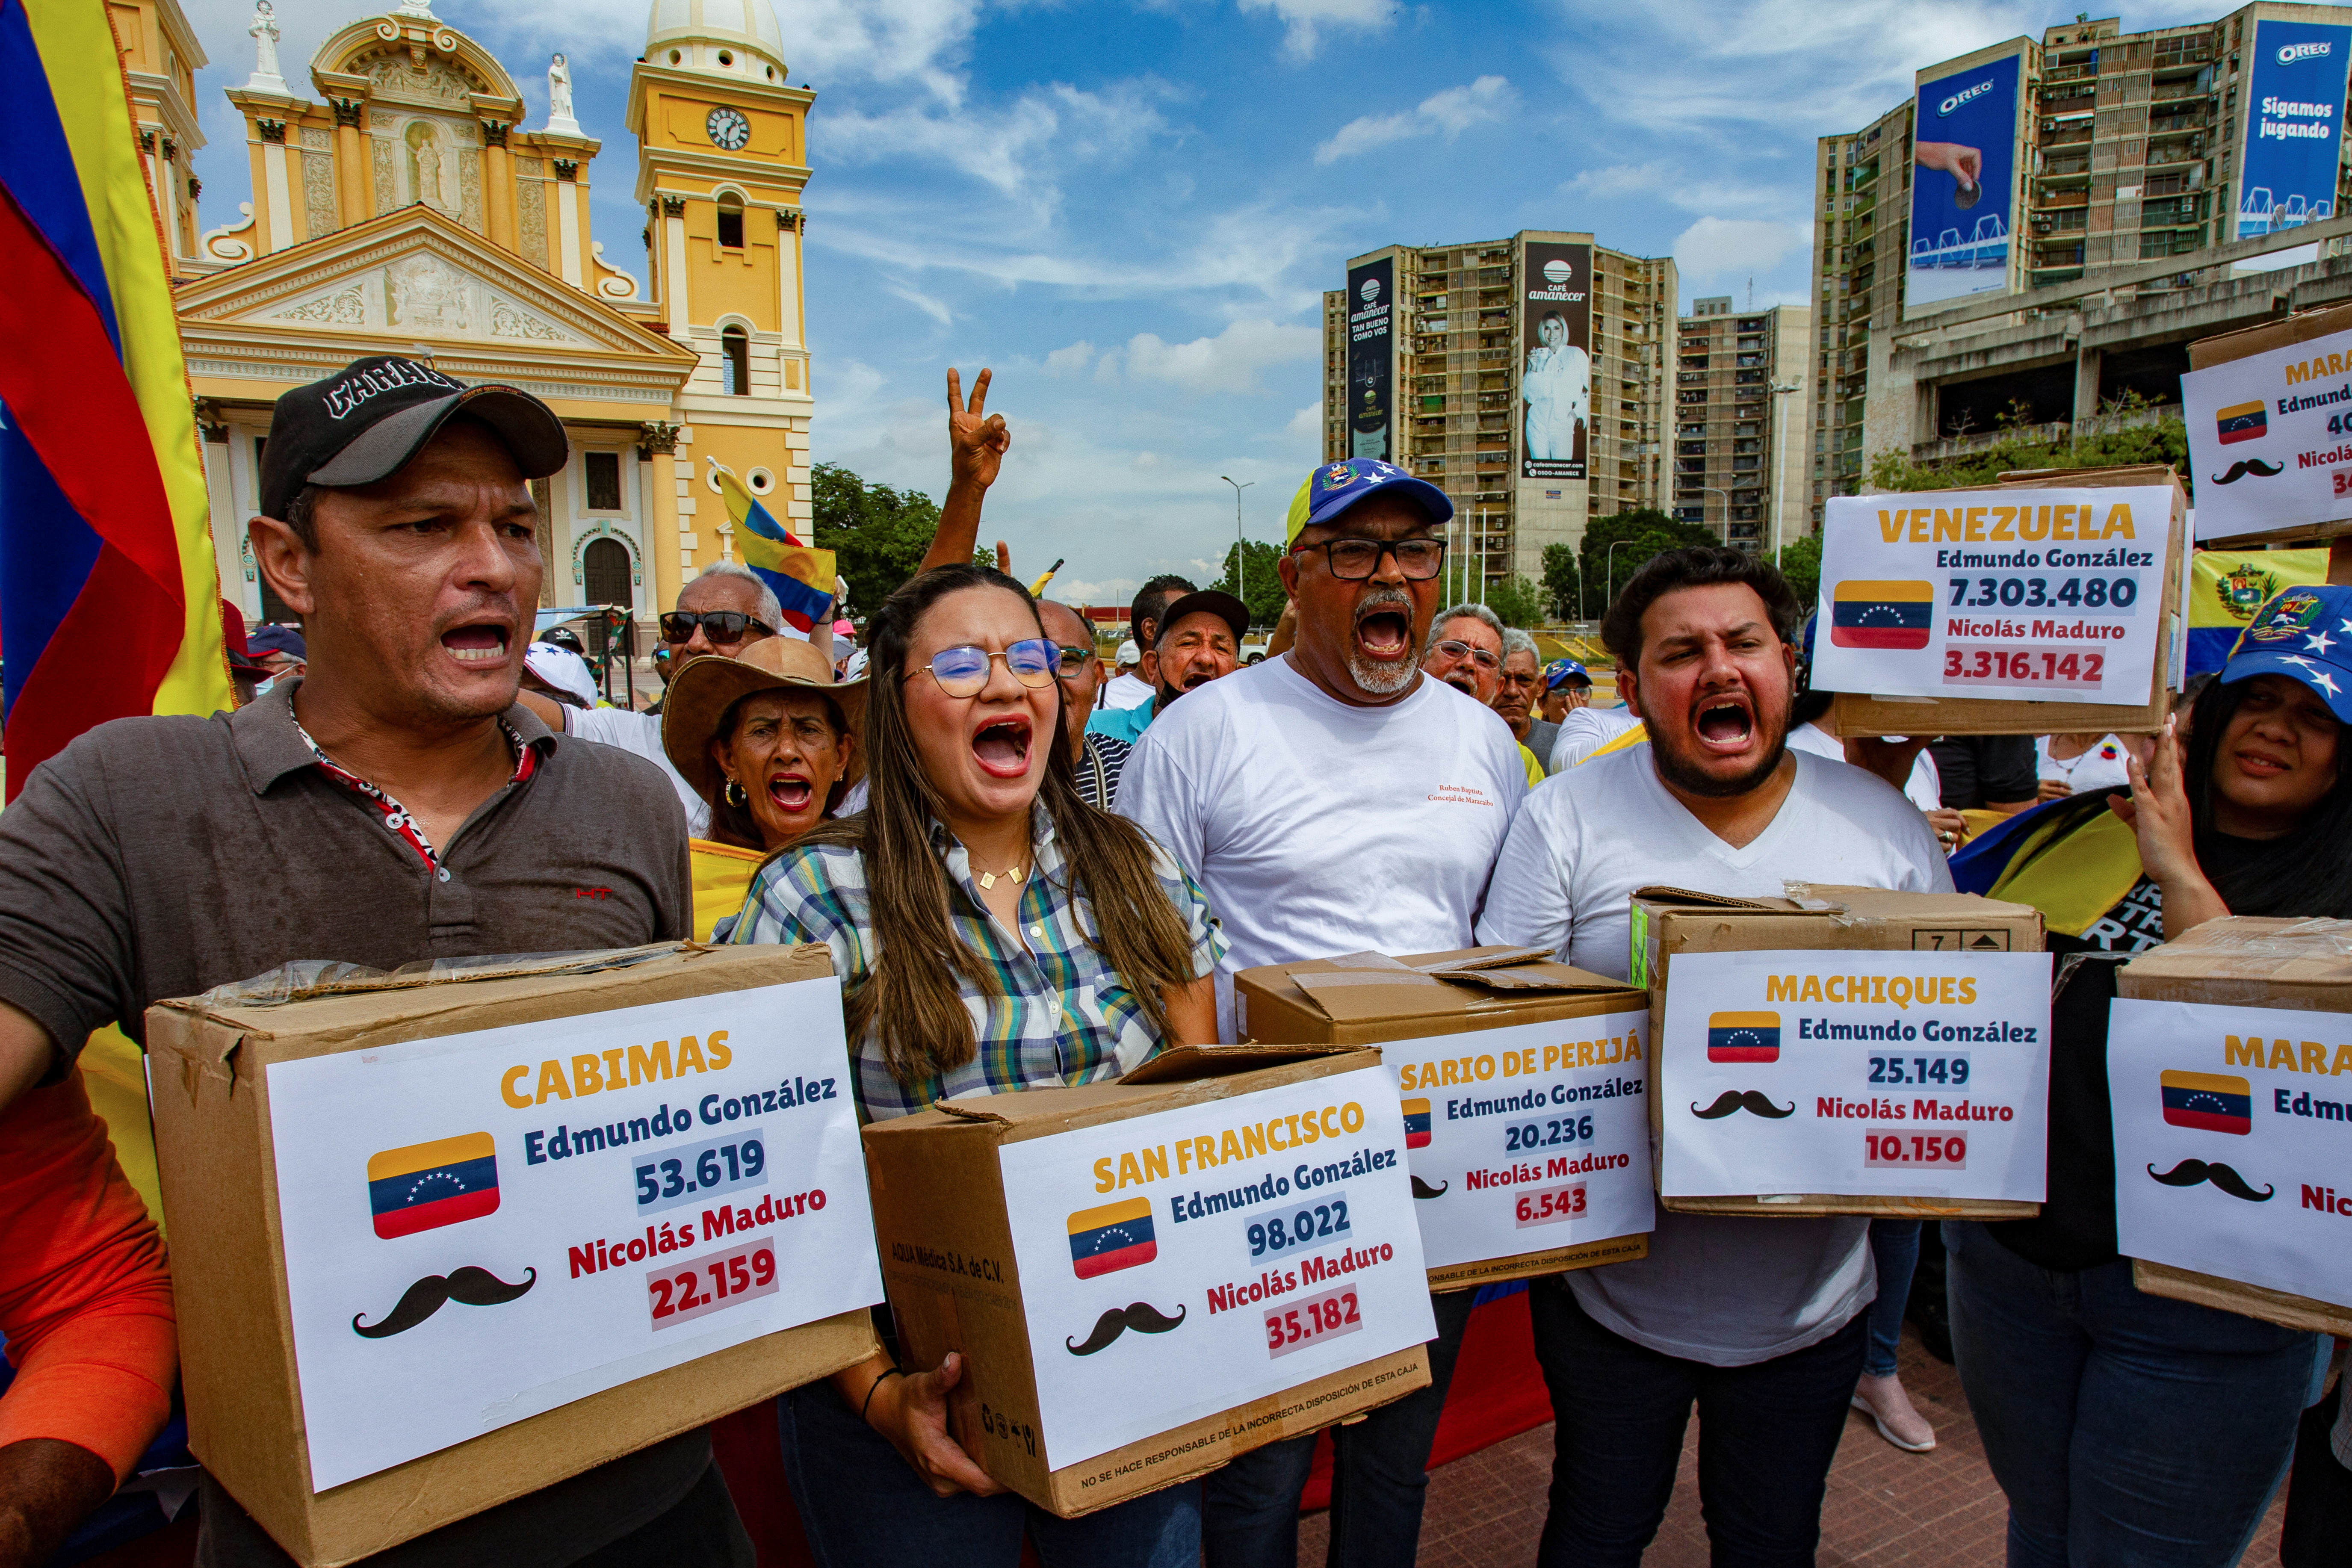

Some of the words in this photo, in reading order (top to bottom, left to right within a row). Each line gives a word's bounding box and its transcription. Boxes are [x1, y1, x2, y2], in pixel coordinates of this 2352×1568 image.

[2278, 44, 2329, 62] OREO
[1939, 82, 1992, 113] OREO
[2261, 96, 2333, 118] Sigamos
[2259, 117, 2330, 140] jugando
[1364, 300, 1377, 310] CAFÉ
[1528, 290, 1586, 301] amanecer
[1351, 304, 1390, 322] amanecer
[1352, 323, 1365, 333] TAN
[1366, 317, 1389, 330] BUENO
[1353, 330, 1373, 342] COMO
[1374, 326, 1387, 336] VOS
[2277, 383, 2352, 416] Edmund
[1878, 503, 2136, 543] VENEZUELA
[1936, 549, 2041, 568] Edmundo
[2045, 547, 2154, 567] González
[1949, 577, 2138, 608] 7.303.480
[1947, 619, 2026, 638] Nicolás
[2031, 620, 2125, 640] Maduro
[1943, 650, 2104, 682] 3.316.142
[1428, 794, 1456, 803] Concejal
[1466, 797, 1493, 806] Maracaibo
[1461, 786, 1483, 795] Baptista
[1931, 936, 1944, 951] 7
[1767, 975, 1977, 1010] MACHIQUES
[1799, 1018, 1918, 1042] Edmundo
[1922, 1020, 2038, 1044] González
[500, 1030, 732, 1109] CABIMAS
[1398, 1054, 1496, 1091] SARIO
[1502, 1048, 1537, 1078] DE
[1543, 1028, 1643, 1072] PERIJÁ
[1868, 1057, 1971, 1085] 25.149
[1447, 1089, 1547, 1121] Edmundo
[1551, 1076, 1643, 1105] González
[1817, 1096, 1906, 1120] Nicolás
[1912, 1099, 2014, 1122] Maduro
[523, 1104, 692, 1166] Edmundo
[698, 1076, 837, 1126] González
[1505, 1114, 1595, 1152] 20.236
[1093, 1145, 1170, 1194] SAN
[1175, 1101, 1365, 1175] FRANCISCO
[1865, 1135, 1966, 1163] 10.150
[635, 1139, 765, 1205] 53.619
[1170, 1173, 1290, 1224] Edmundo
[1294, 1148, 1397, 1191] González
[1466, 1163, 1542, 1191] Nicolás
[1547, 1152, 1630, 1179] Maduro
[1516, 1184, 1587, 1222] 6.543
[567, 1221, 695, 1279] Nicolás
[701, 1189, 827, 1242] Maduro
[1247, 1200, 1351, 1257] 98.022
[892, 1242, 916, 1264] AQUA
[916, 1246, 947, 1271] Médica
[948, 1252, 968, 1276] S.A.
[969, 1256, 982, 1279] de
[983, 1258, 1004, 1284] C.V.
[1206, 1269, 1297, 1315] Nicolás
[1300, 1243, 1393, 1286] Maduro
[1427, 1270, 1465, 1282] ONSABLE
[1491, 1260, 1539, 1272] INCORRECTA
[1541, 1251, 1588, 1265] DISPOSICIÓN
[1590, 1249, 1600, 1258] DE
[1602, 1246, 1620, 1256] ESTA
[1622, 1243, 1641, 1252] CAJA
[649, 1248, 776, 1320] 22.159
[1265, 1292, 1361, 1350] 35.182
[1081, 1477, 1097, 1489] NO
[1099, 1471, 1113, 1483] SE
[1114, 1461, 1142, 1477] HACE
[1145, 1434, 1217, 1467] RESPONSABLE
[1218, 1428, 1231, 1440] DE
[1232, 1424, 1246, 1436] LA
[1247, 1404, 1305, 1430] INCORRECTA
[1306, 1383, 1361, 1410] DISPOSICIÓN
[1362, 1378, 1374, 1389] DE
[1375, 1371, 1396, 1386] ESTA
[1397, 1363, 1418, 1379] CAJA
